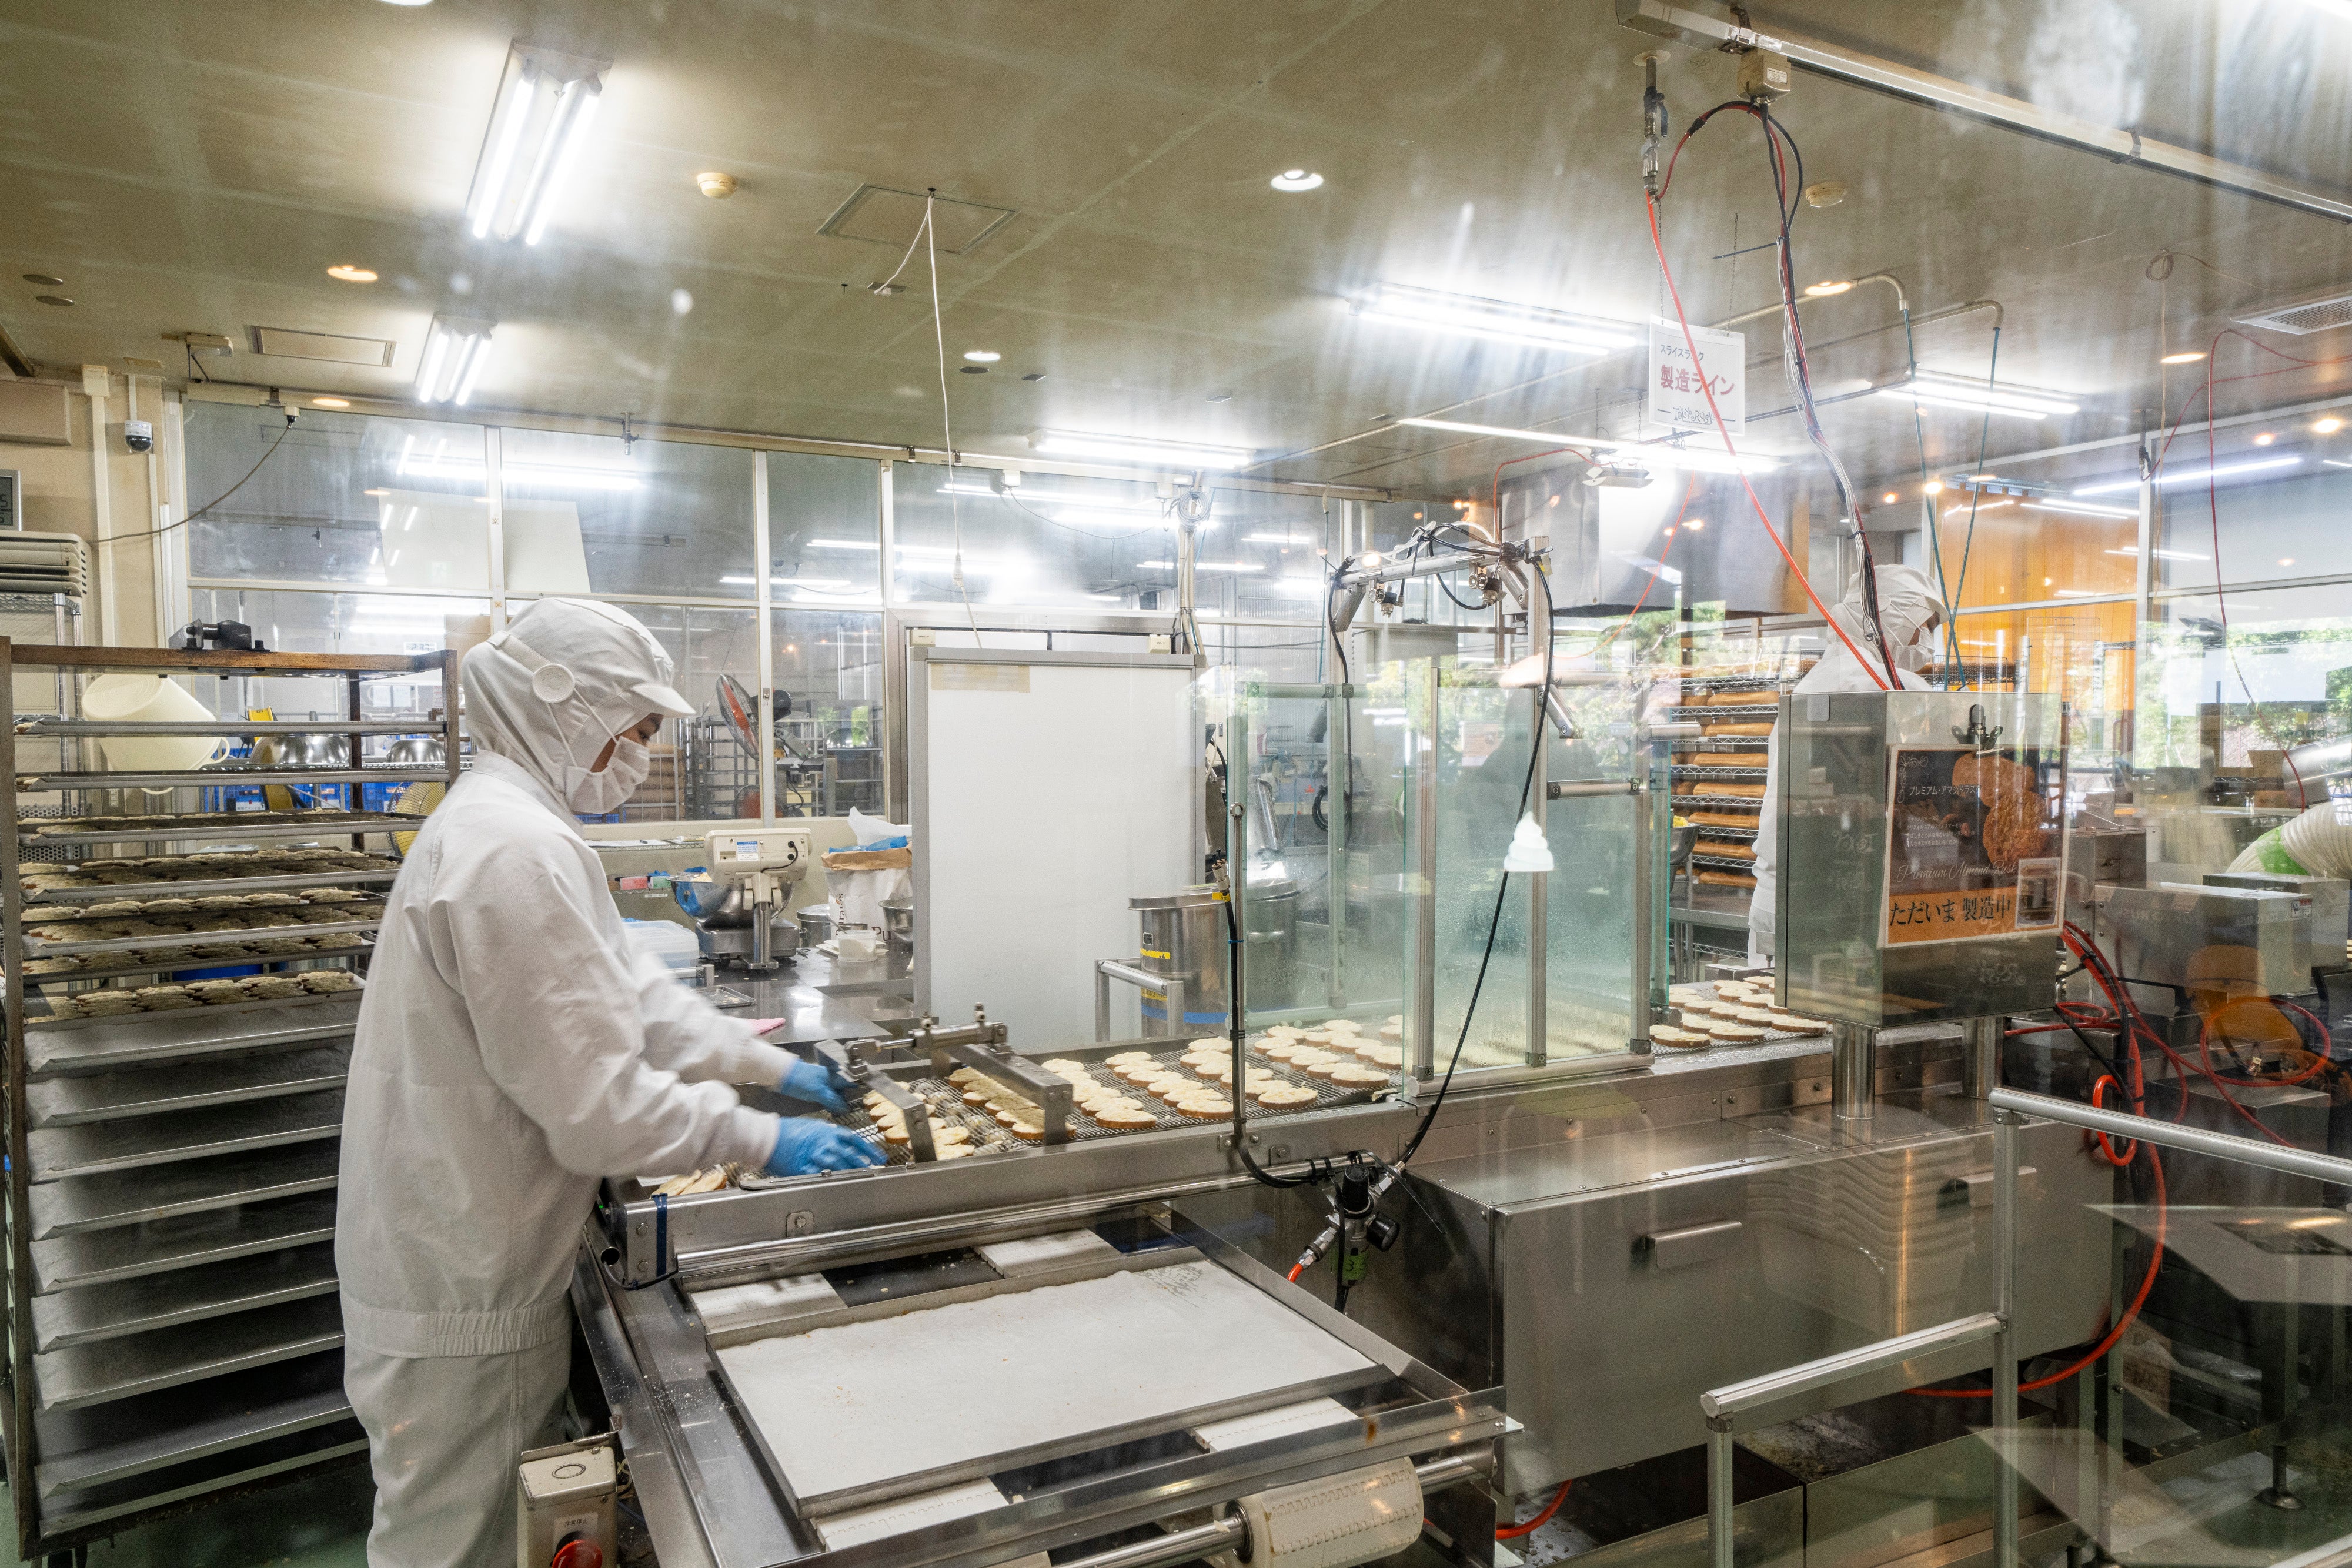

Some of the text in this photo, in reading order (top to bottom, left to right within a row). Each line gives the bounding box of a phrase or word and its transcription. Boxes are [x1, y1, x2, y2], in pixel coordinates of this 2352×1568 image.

[1661, 345, 1704, 361] スライスラク
[1661, 365, 1735, 396] 製造ライン
[1897, 865, 1946, 882] Premium
[1949, 861, 1992, 880] Almond
[1890, 895, 2011, 926] ただいま 製造中
